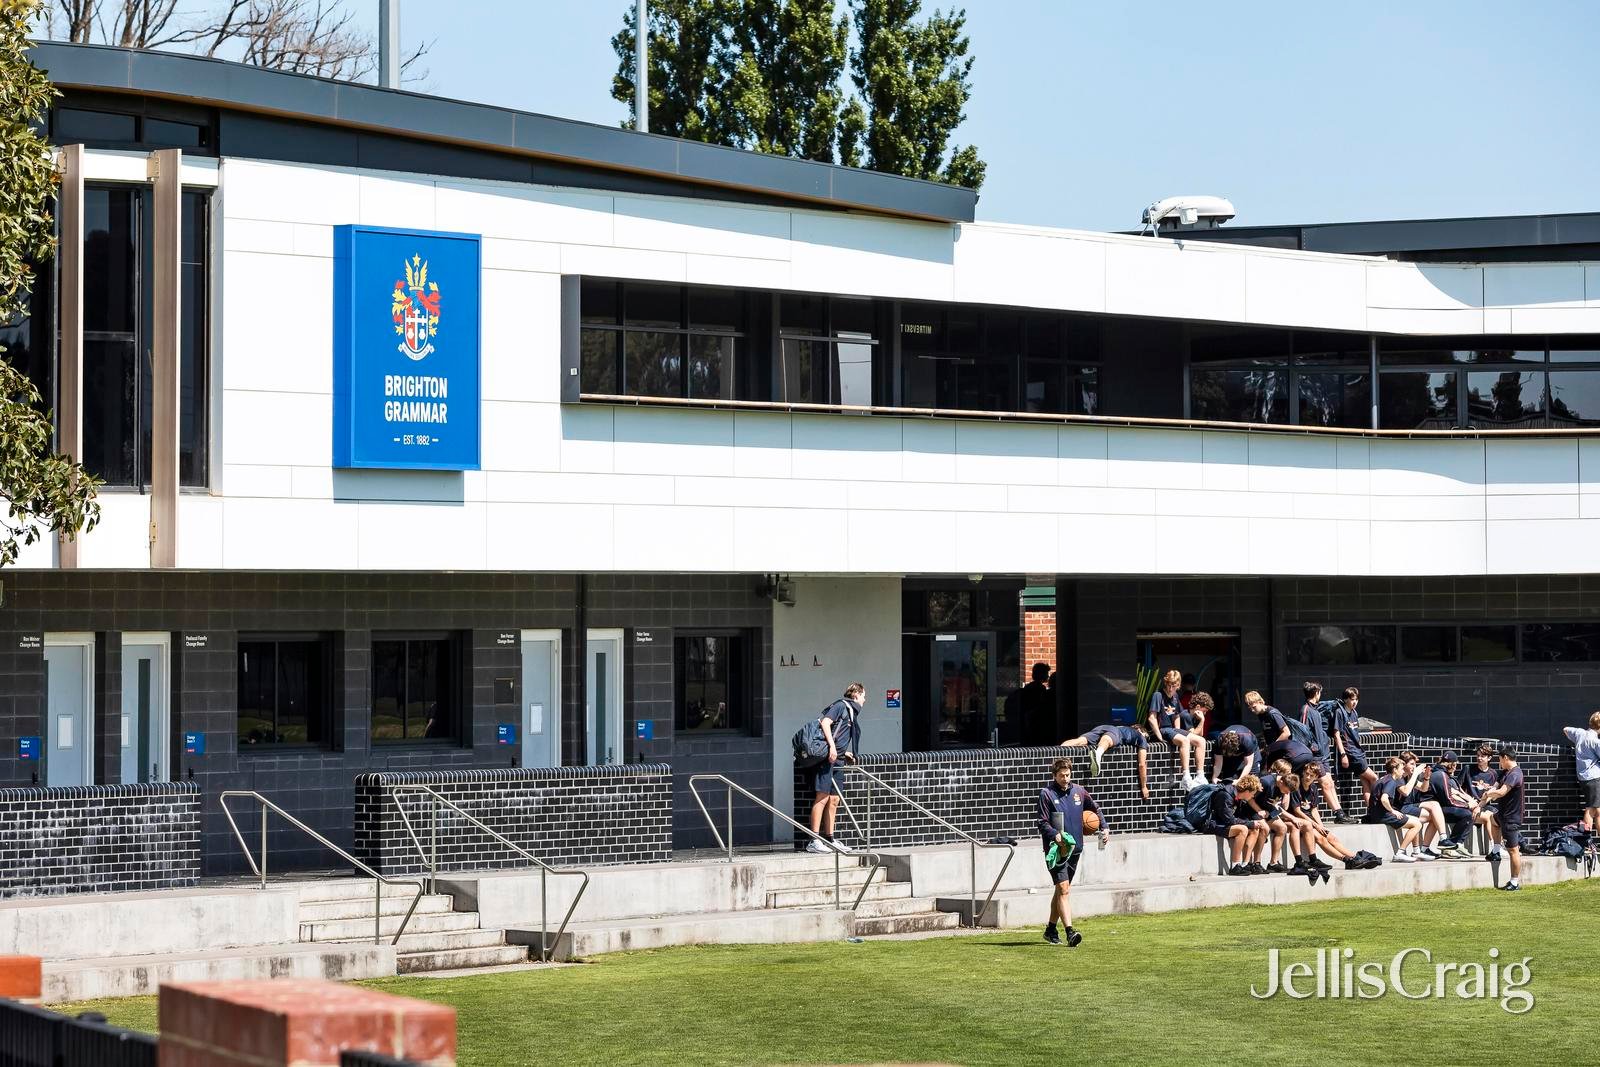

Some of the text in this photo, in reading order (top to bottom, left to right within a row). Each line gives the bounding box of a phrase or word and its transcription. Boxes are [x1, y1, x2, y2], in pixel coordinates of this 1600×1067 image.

[384, 375, 448, 399] BRIGHTON
[384, 401, 448, 424] GRAMMAR
[403, 435, 430, 446] EST. 1882
